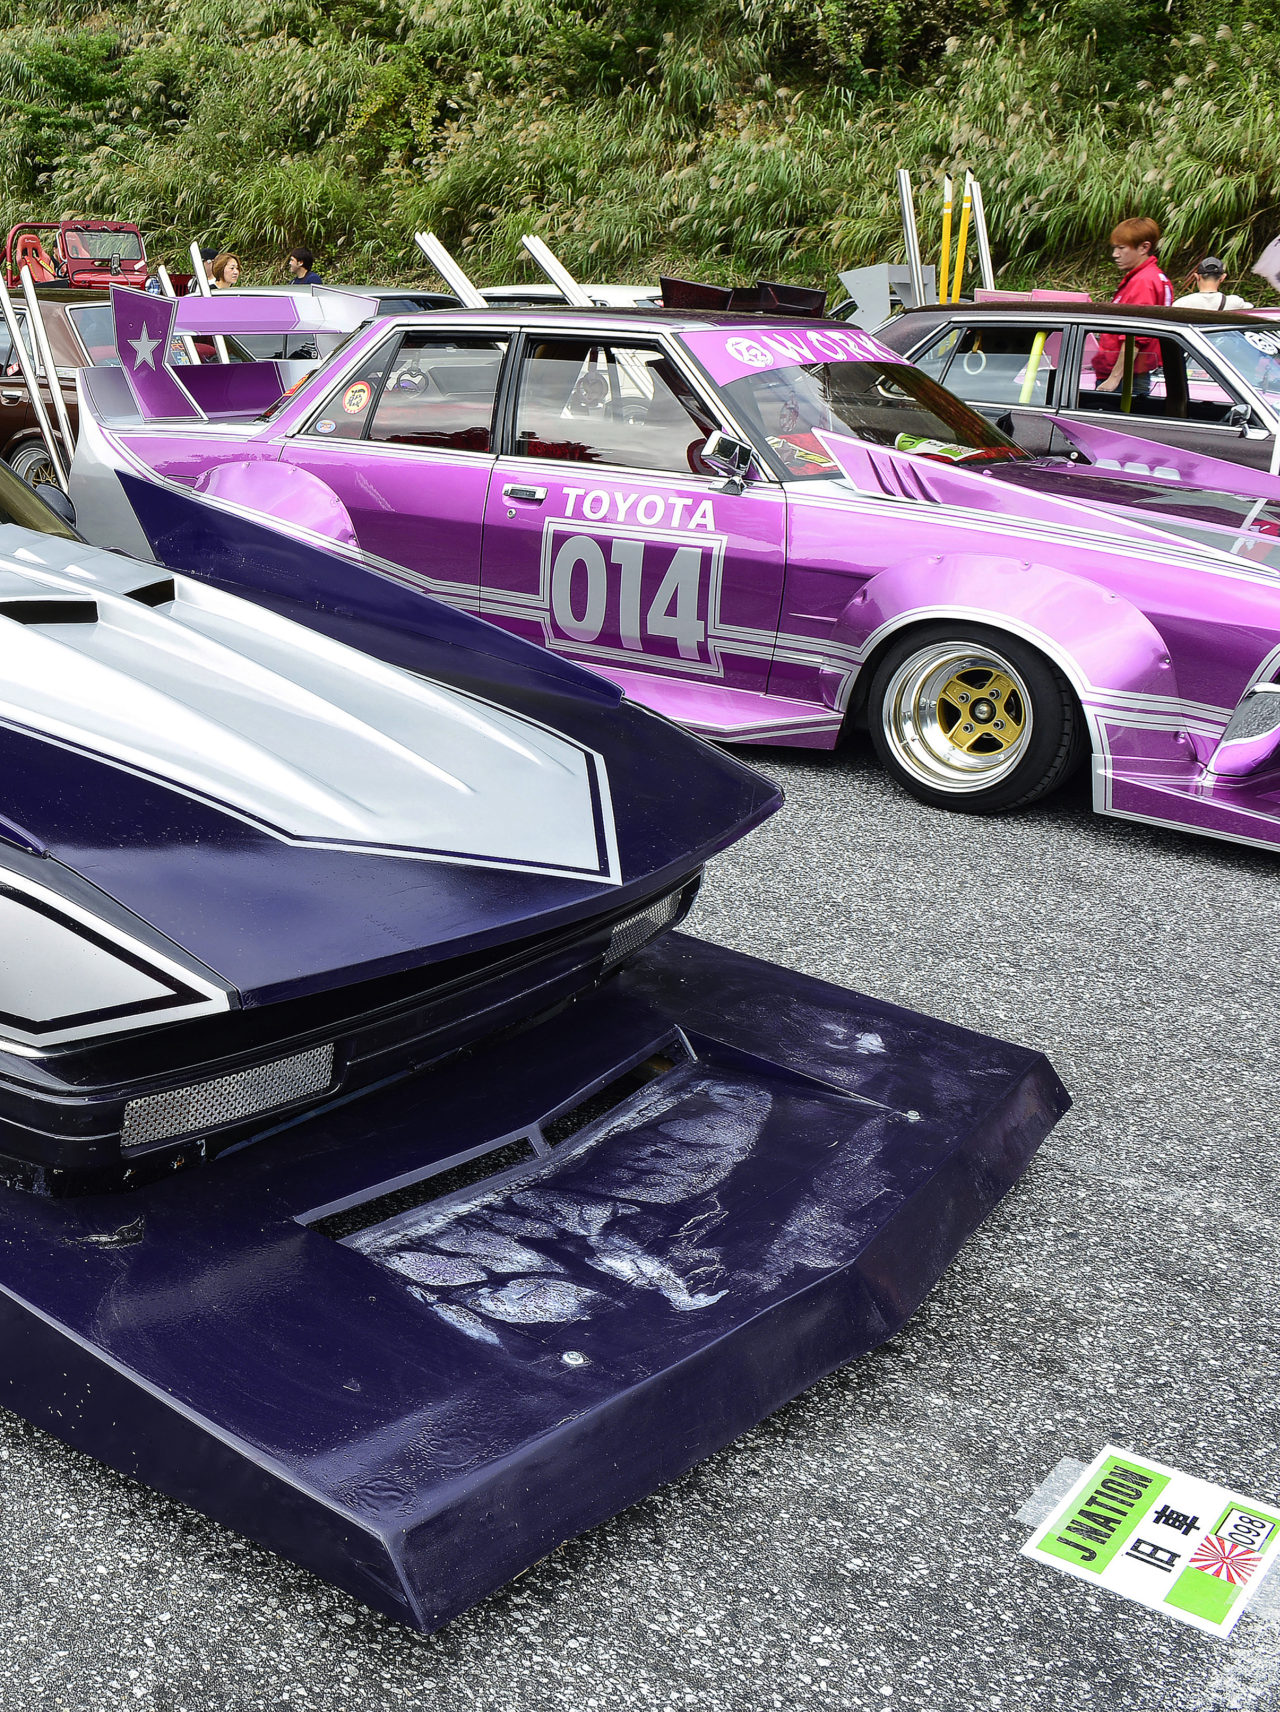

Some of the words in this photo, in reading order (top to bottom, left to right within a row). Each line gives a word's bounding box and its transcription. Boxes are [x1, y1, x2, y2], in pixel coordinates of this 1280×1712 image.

[761, 331, 896, 362] WORK
[562, 487, 716, 531] TOYOTA
[552, 535, 705, 660] 014
[1065, 1465, 1154, 1545] NATION
[1227, 1515, 1266, 1546] 098
